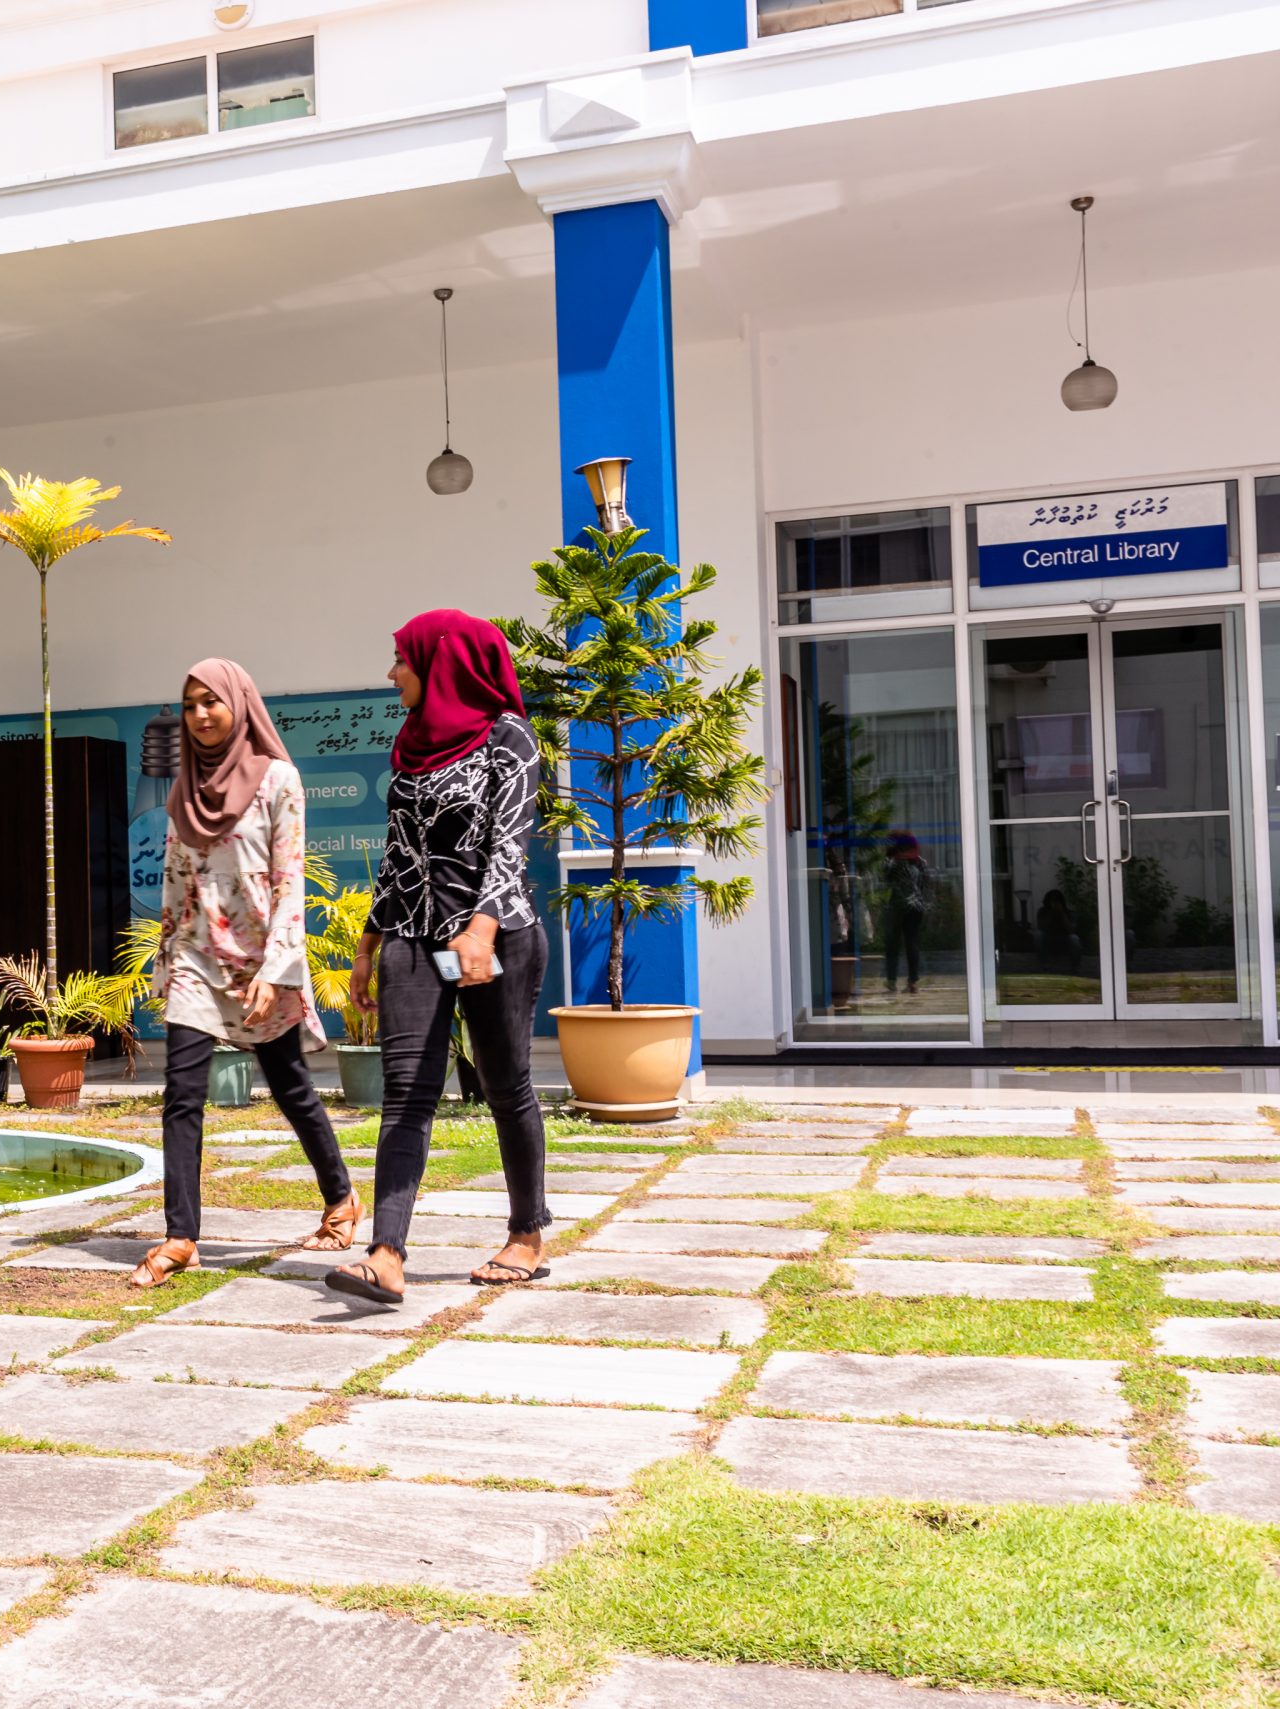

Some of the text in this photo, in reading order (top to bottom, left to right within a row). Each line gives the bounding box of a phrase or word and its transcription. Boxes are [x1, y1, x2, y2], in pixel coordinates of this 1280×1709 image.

[1023, 541, 1180, 568] Central Library
[305, 785, 358, 798] merce
[351, 834, 387, 850] Issue
